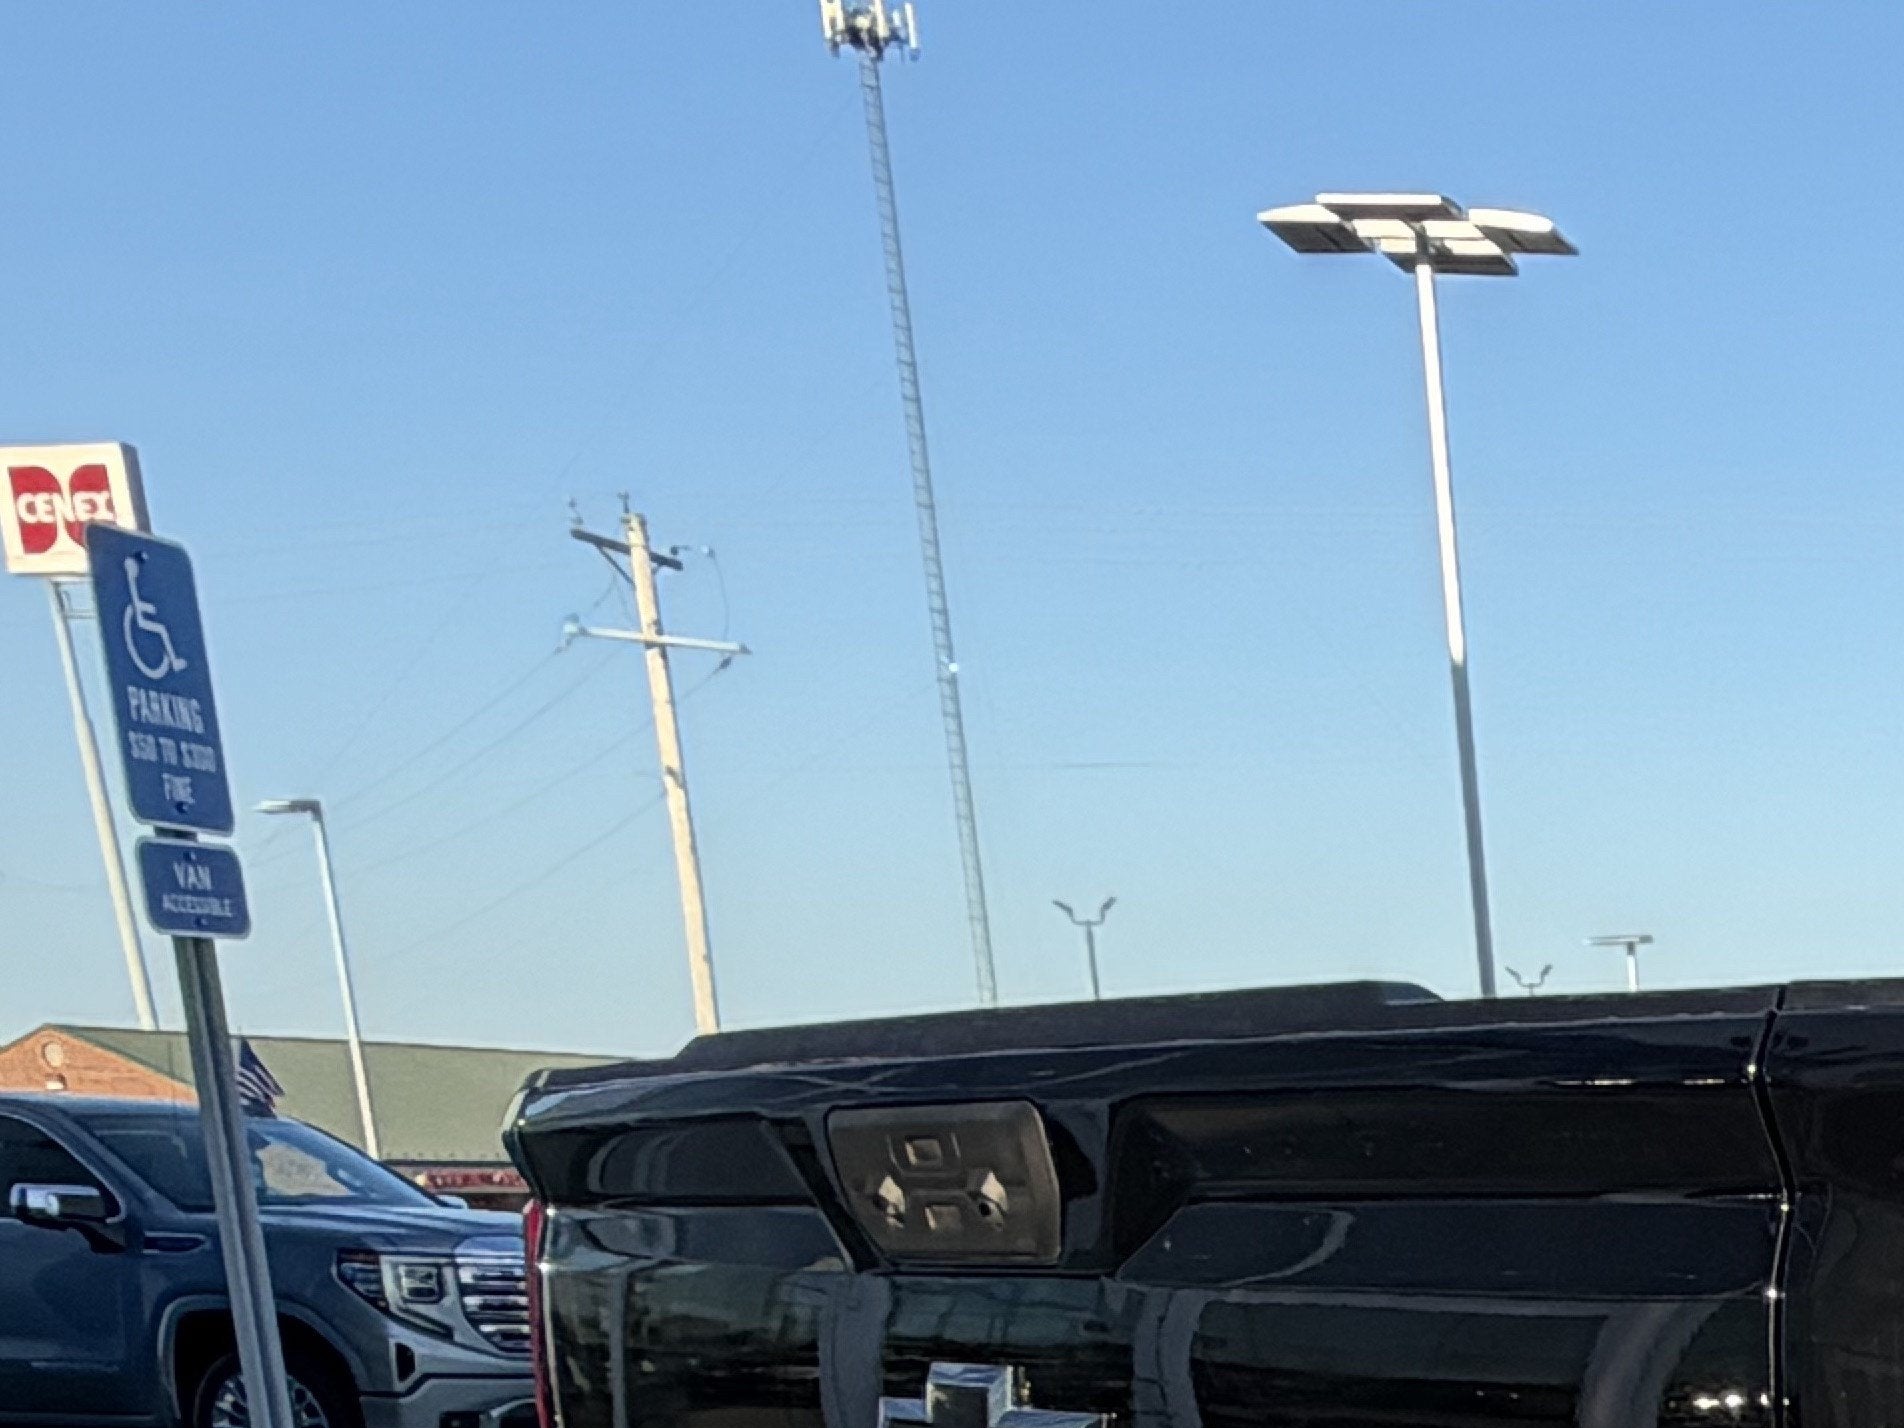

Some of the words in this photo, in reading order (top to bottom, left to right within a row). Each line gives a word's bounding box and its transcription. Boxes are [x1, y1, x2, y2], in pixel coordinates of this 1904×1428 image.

[16, 491, 117, 523] CENEX
[127, 686, 205, 733] PARKING
[173, 862, 212, 890] VAN
